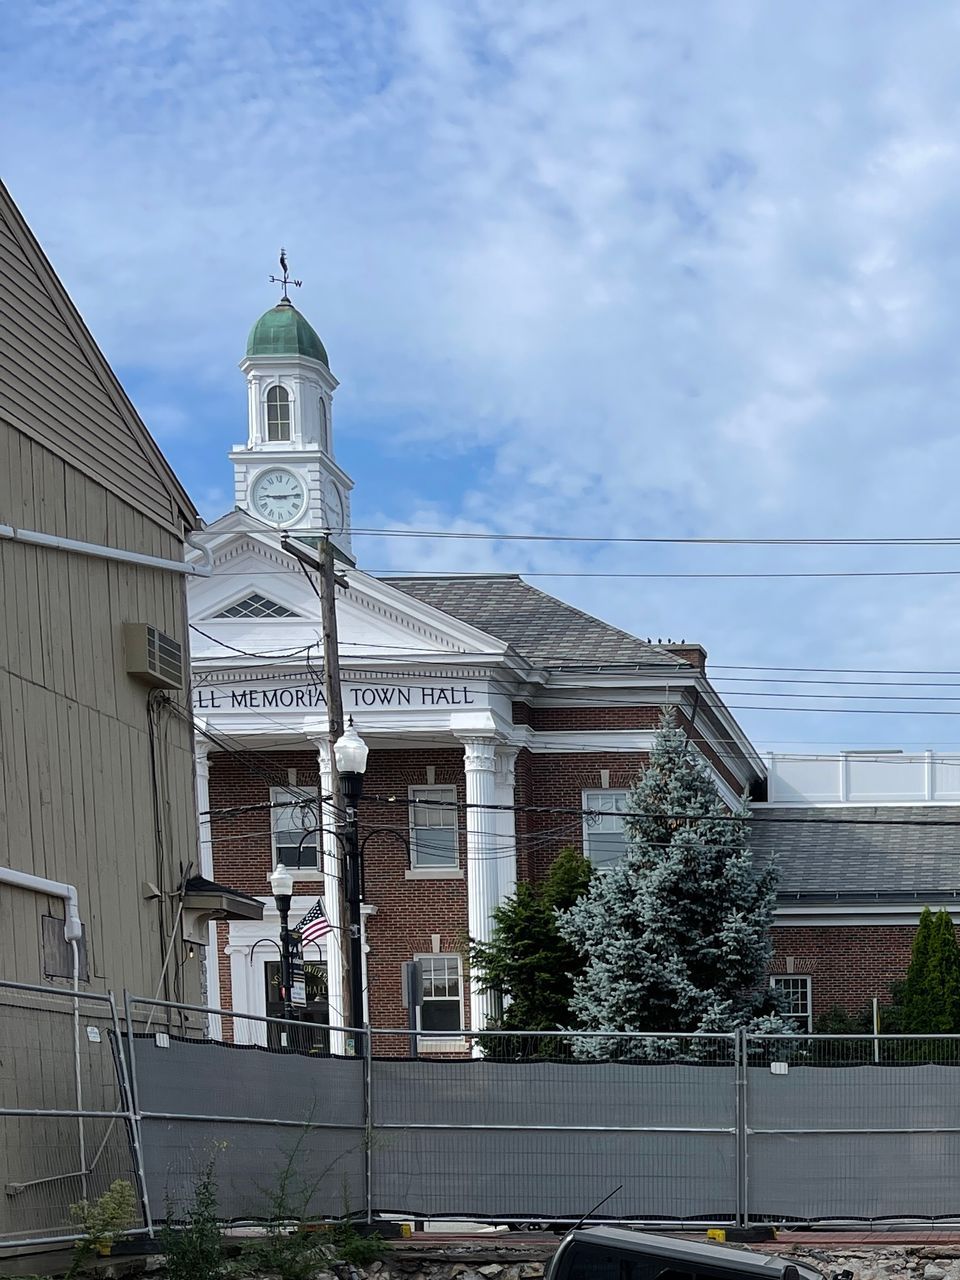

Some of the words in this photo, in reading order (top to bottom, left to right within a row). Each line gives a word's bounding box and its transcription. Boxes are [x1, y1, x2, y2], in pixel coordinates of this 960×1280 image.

[231, 689, 328, 708] MEMORIA
[350, 687, 411, 706] TOWN
[421, 686, 474, 705] HALL
